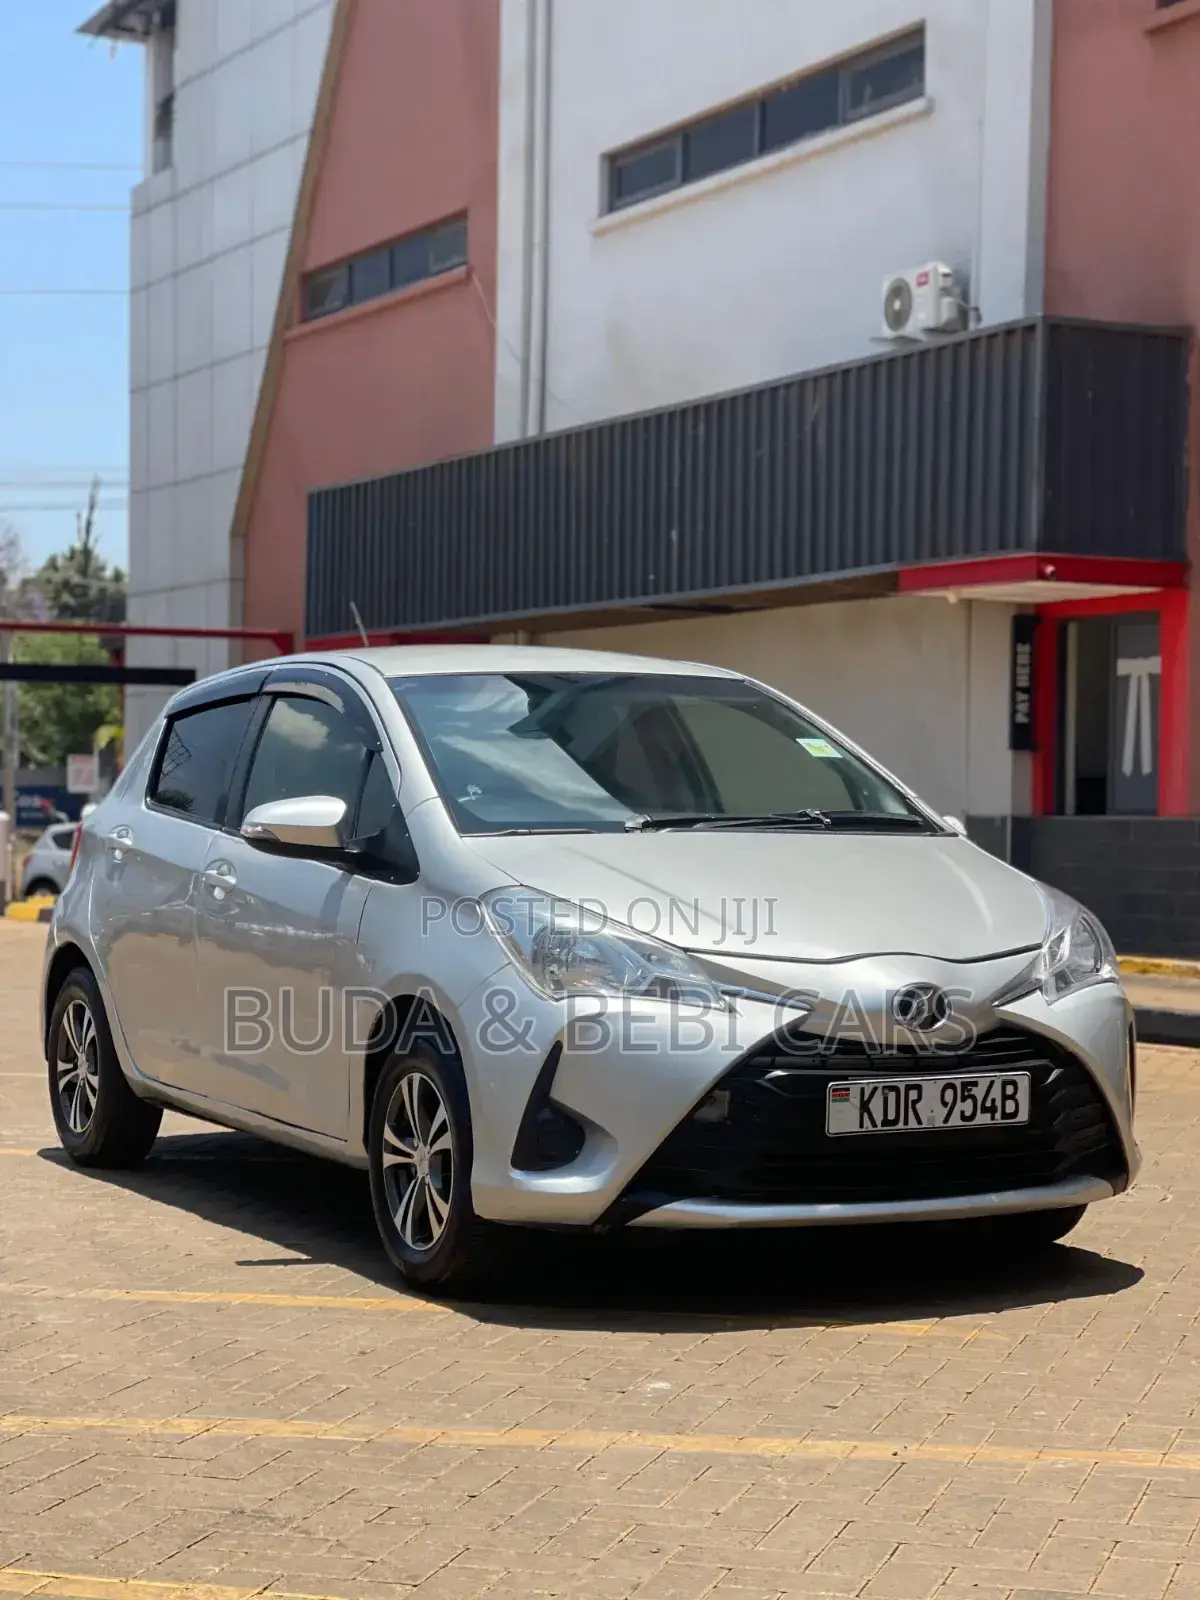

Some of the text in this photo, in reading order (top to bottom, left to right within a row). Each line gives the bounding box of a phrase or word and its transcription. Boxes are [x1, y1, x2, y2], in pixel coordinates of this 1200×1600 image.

[1014, 642, 1031, 724] PAY HERE
[859, 1078, 1020, 1129] KDR 954B
